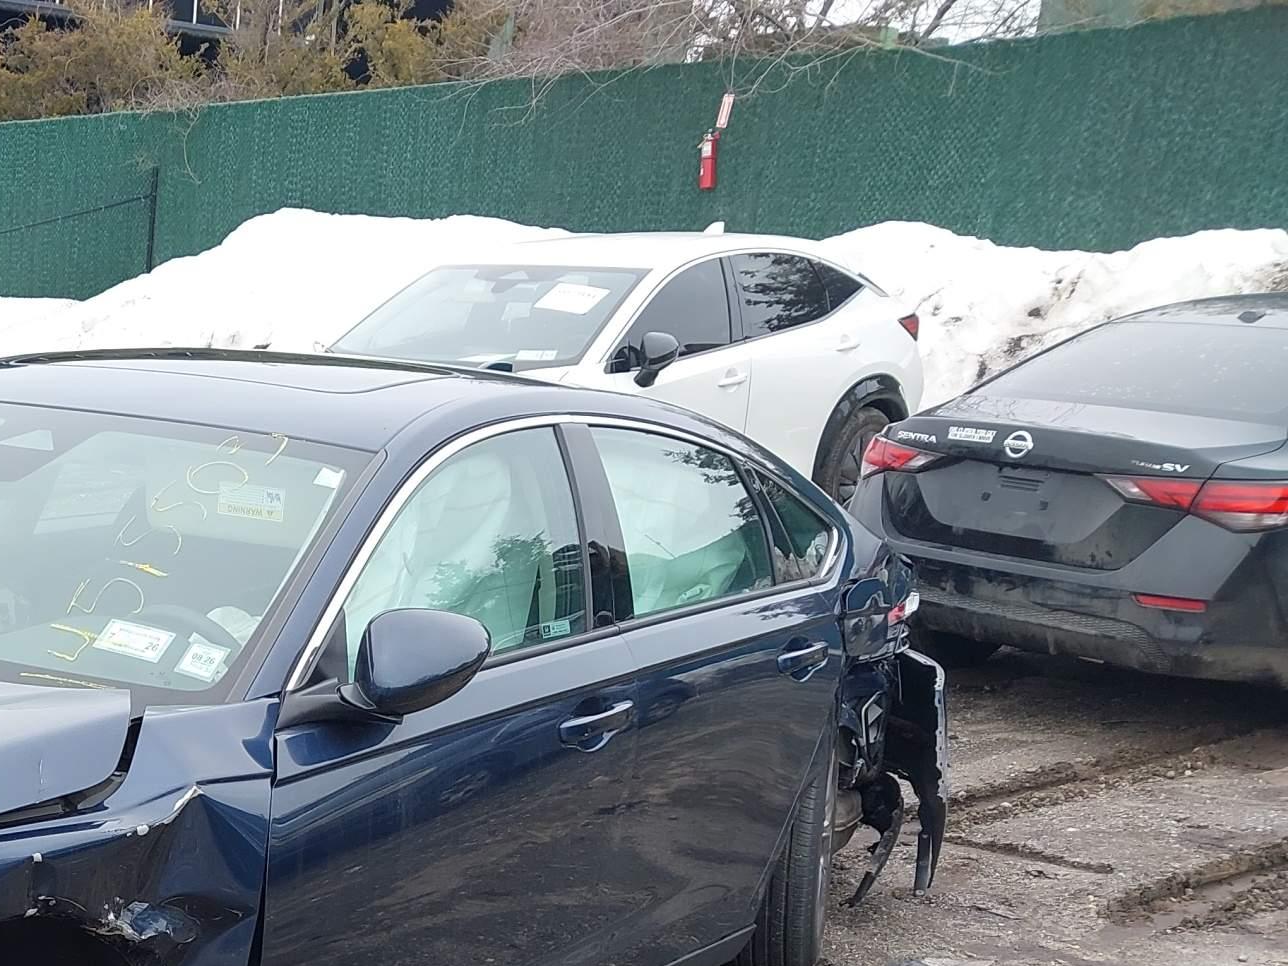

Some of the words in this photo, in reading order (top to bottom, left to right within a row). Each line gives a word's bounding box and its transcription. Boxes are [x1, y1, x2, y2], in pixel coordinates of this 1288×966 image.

[897, 430, 937, 444] SENTRA
[1161, 462, 1192, 473] SV
[227, 505, 264, 517] WARNING
[144, 642, 160, 652] 26
